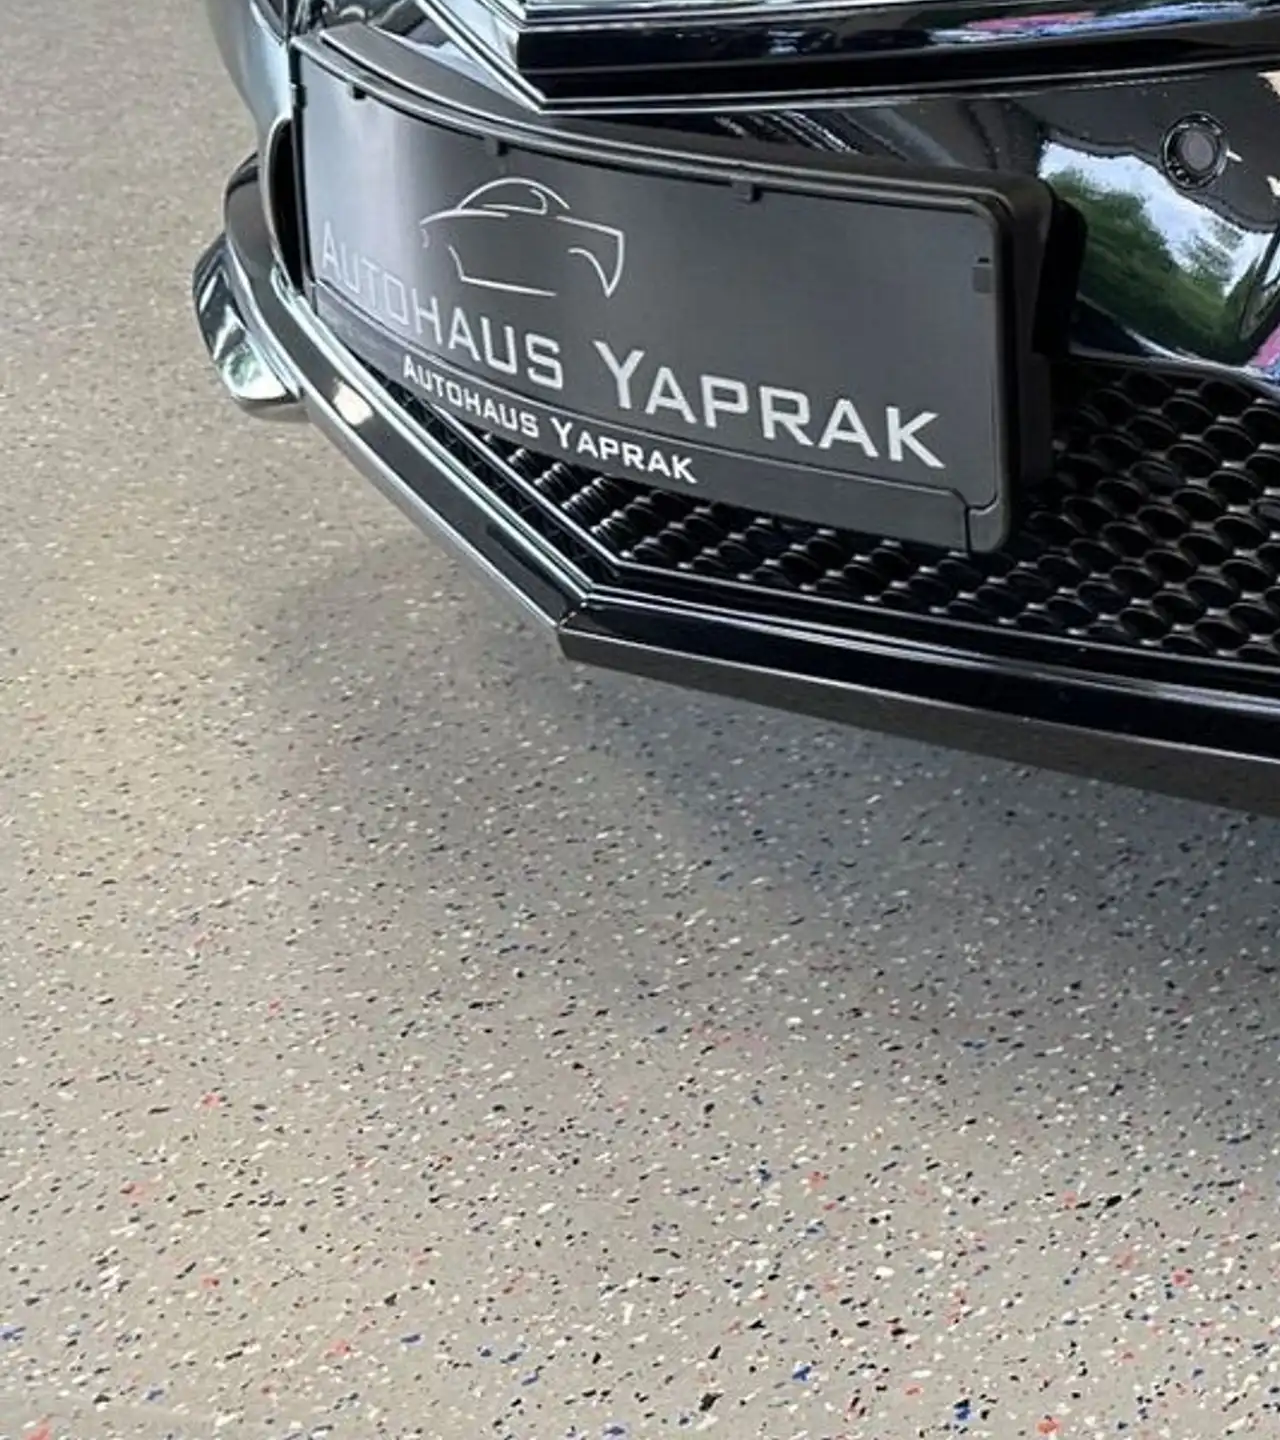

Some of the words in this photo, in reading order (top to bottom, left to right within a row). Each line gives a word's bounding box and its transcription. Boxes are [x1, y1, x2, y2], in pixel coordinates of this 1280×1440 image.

[322, 220, 564, 390] AUTOHAUS
[593, 339, 946, 470] YAPRAK
[402, 354, 540, 438] AUTOHAUS
[550, 416, 698, 485] YAPRAK
